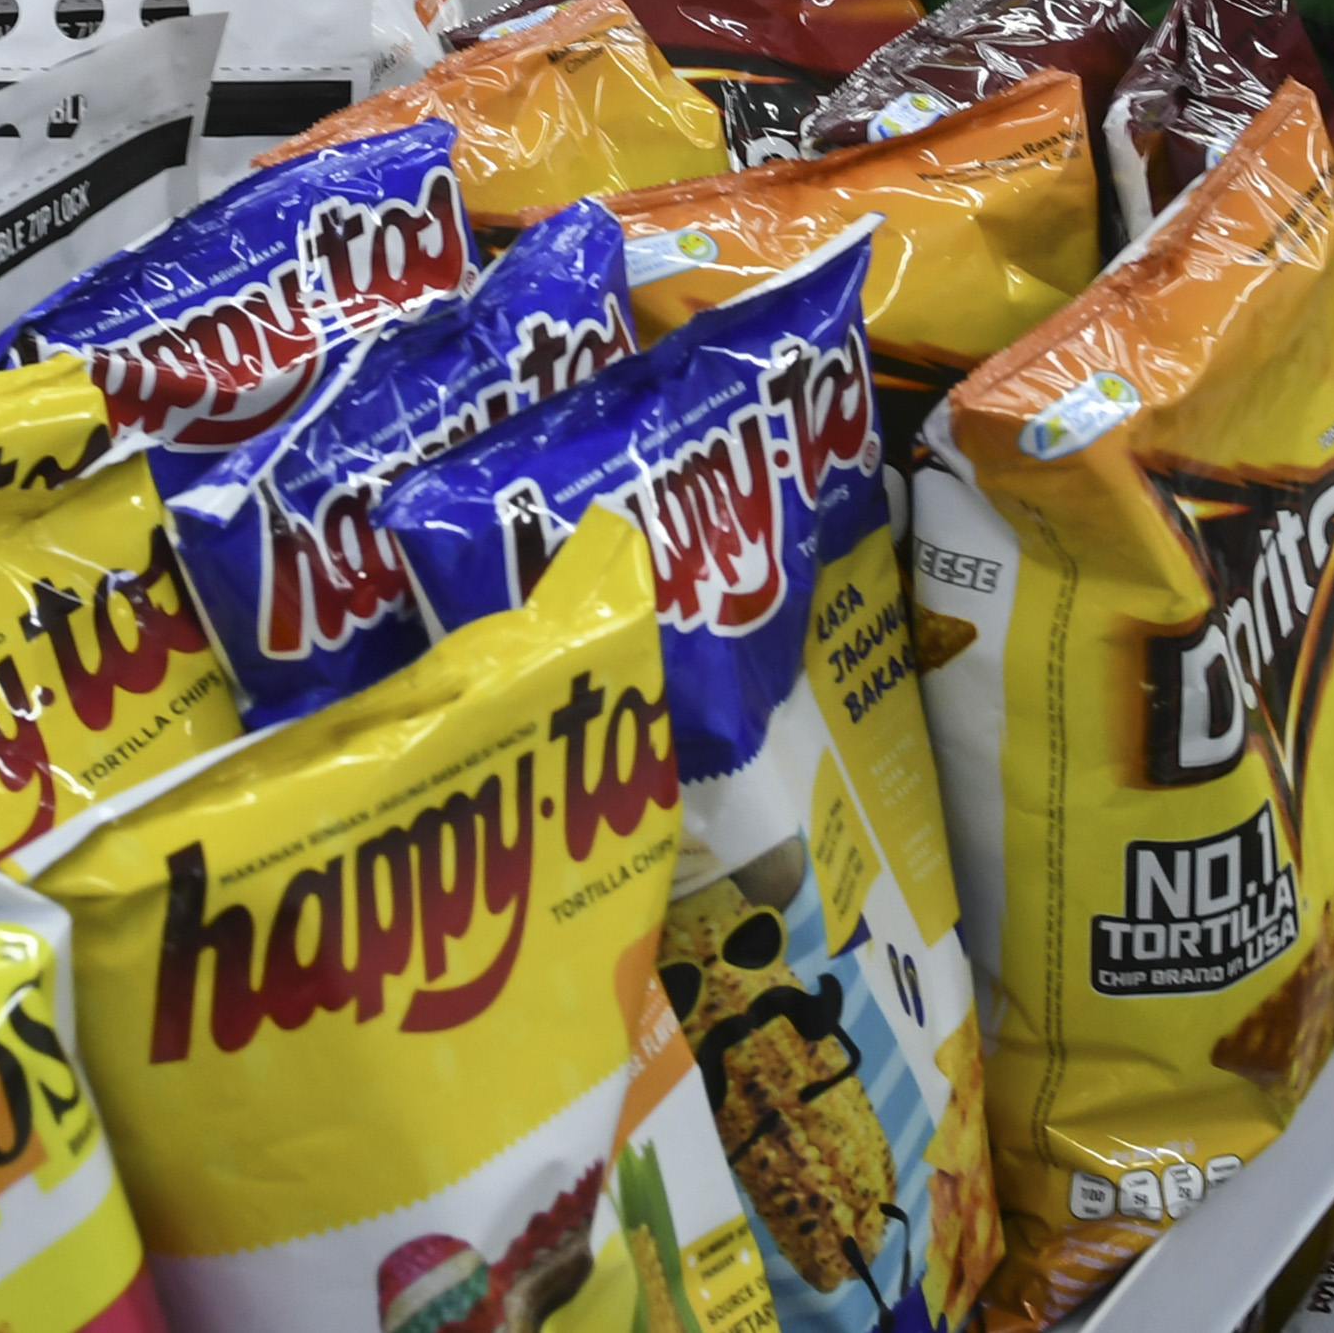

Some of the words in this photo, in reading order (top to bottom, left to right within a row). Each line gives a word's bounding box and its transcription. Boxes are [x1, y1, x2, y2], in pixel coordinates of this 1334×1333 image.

[26, 206, 53, 246] ZIP
[53, 180, 92, 232] LOCK
[917, 540, 1003, 594] EESE
[81, 708, 173, 789] TORTILLA
[170, 671, 222, 726] CHIPS
[549, 866, 632, 924] TORTILLA
[1135, 813, 1276, 920] NO.1
[1097, 968, 1147, 988] CHIP
[1150, 964, 1224, 986] BRAND
[1246, 917, 1298, 970] USA
[1098, 873, 1295, 961] TORTILLA
